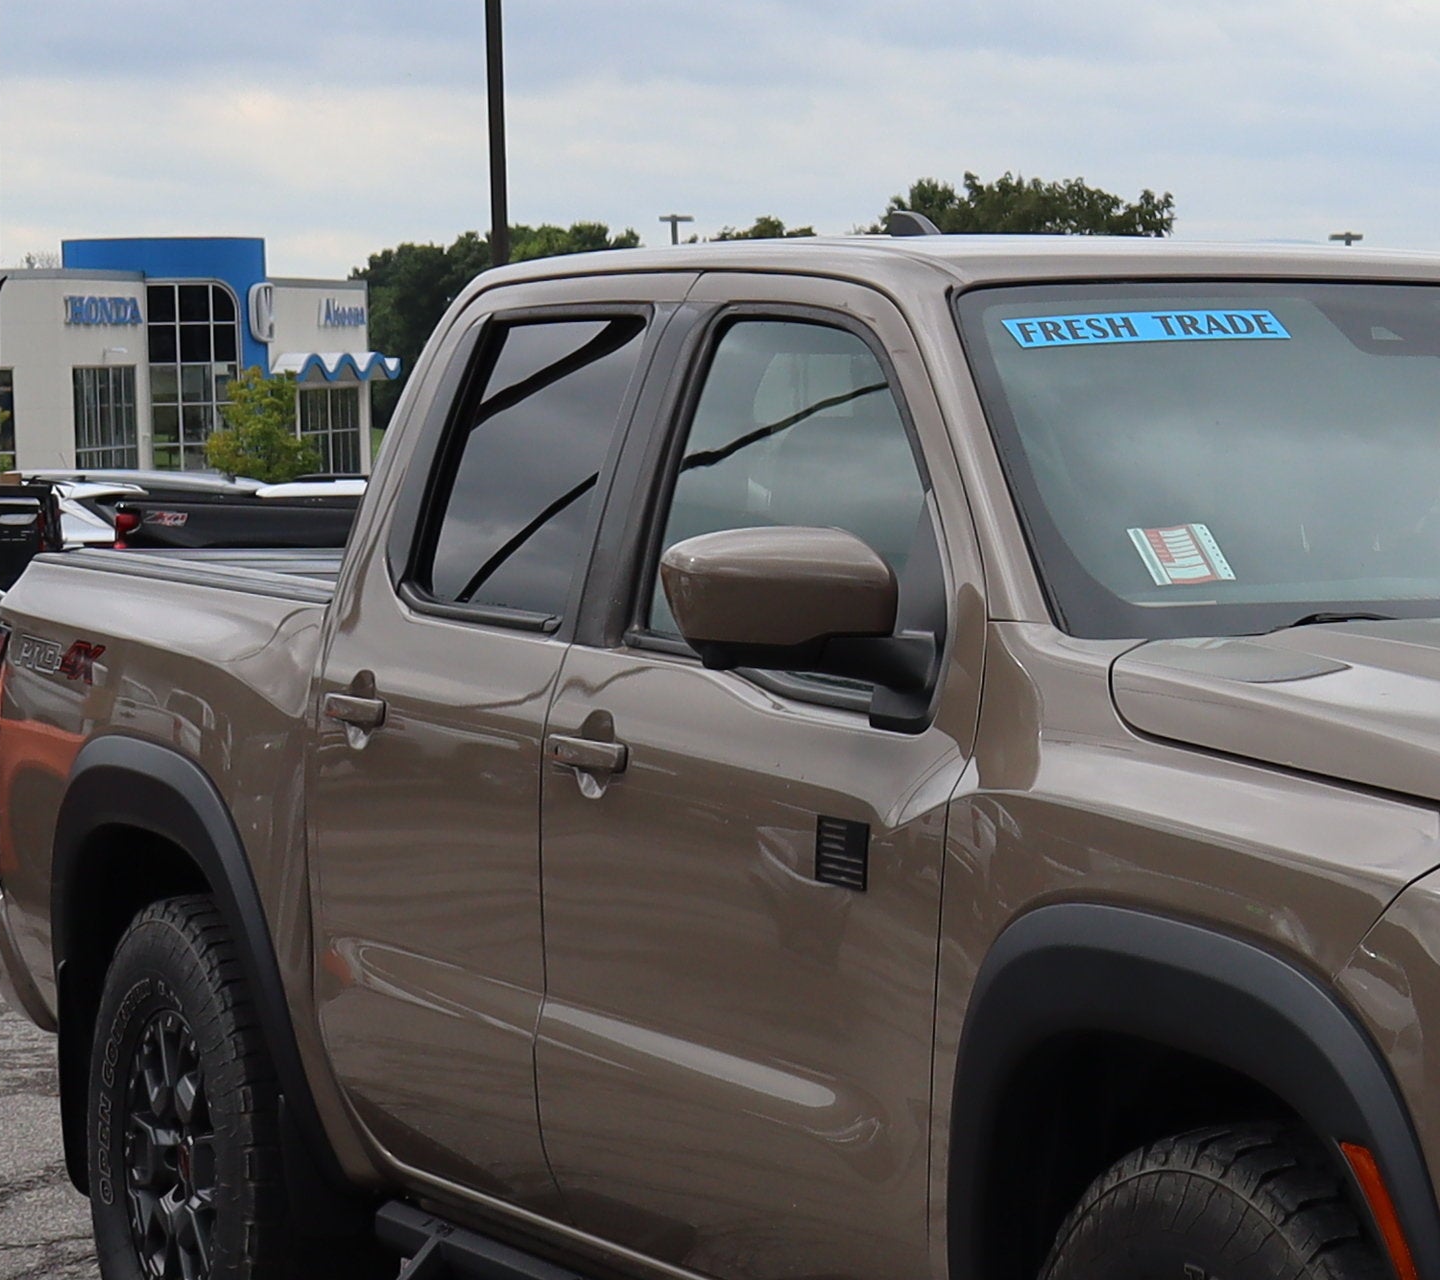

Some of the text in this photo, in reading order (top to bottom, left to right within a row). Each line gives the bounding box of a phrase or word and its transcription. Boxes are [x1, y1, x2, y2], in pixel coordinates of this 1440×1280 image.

[64, 295, 143, 324] HONDA
[1016, 314, 1278, 343] FRESH TRADE
[98, 1091, 114, 1206] OPEN
